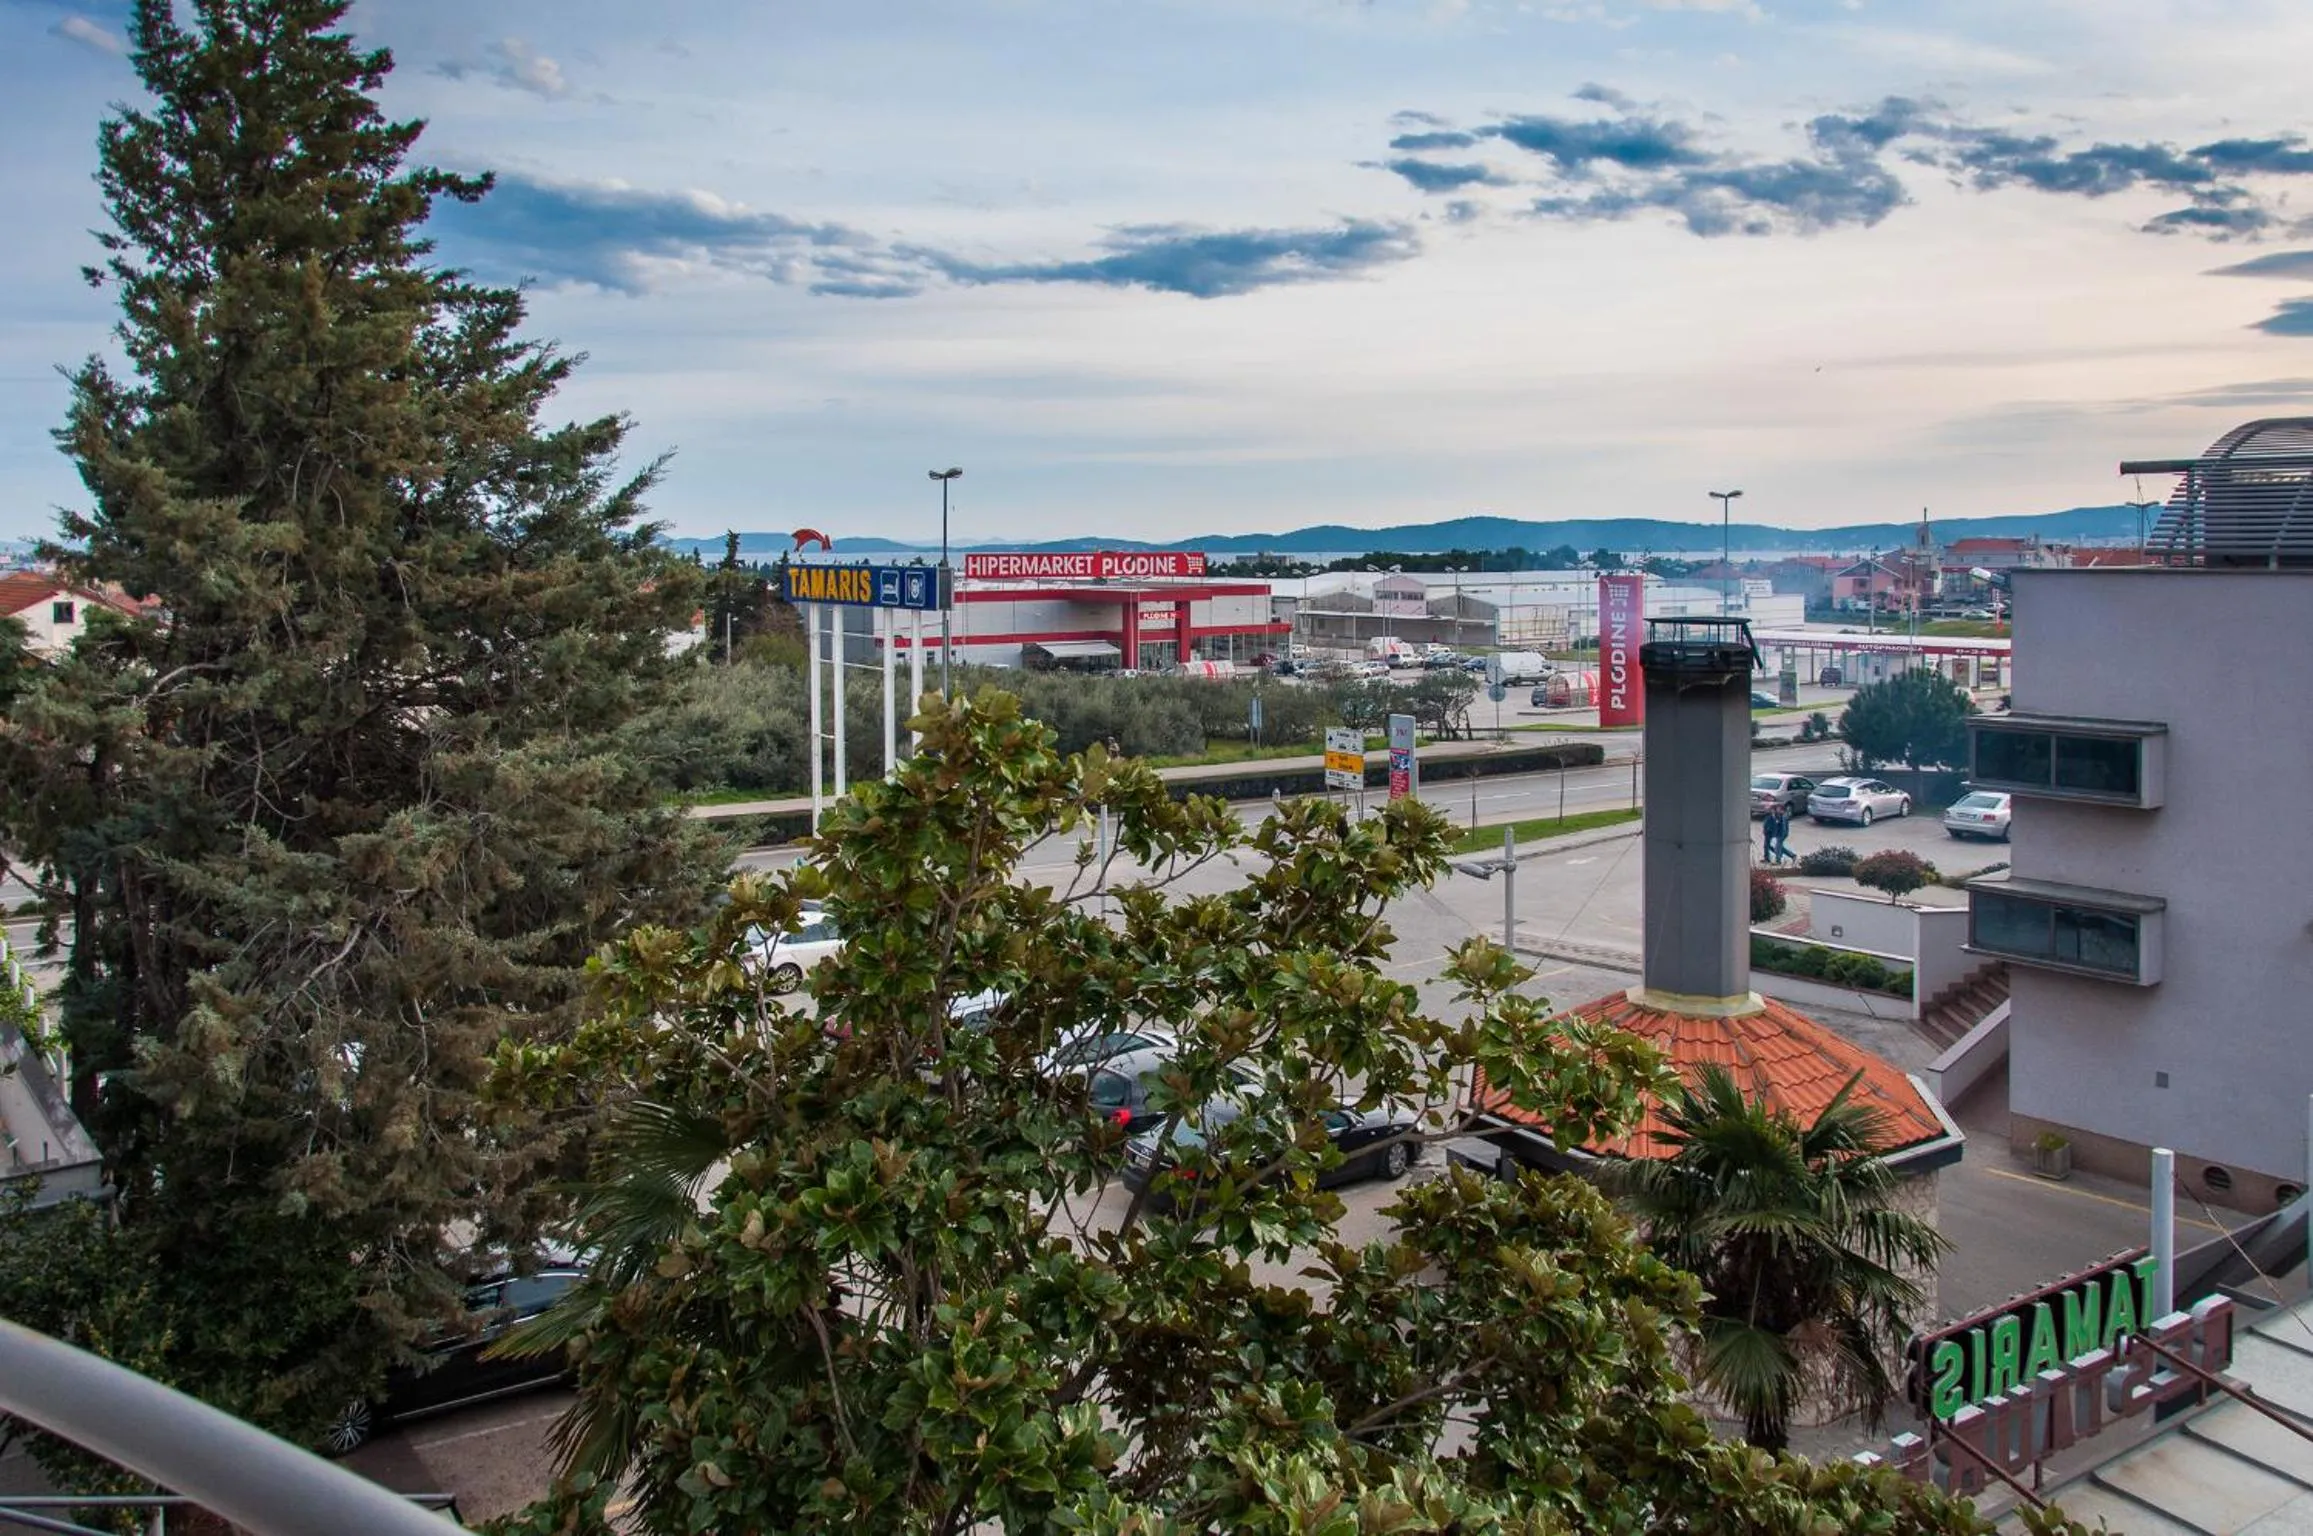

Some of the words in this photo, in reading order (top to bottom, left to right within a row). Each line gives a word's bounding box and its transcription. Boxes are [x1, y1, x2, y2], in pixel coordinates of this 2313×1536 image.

[968, 555, 1094, 576] HIPERMARKET
[1102, 555, 1177, 576] PLODINE
[788, 567, 873, 603] TAMARIS
[1611, 611, 1627, 709] PLODINE
